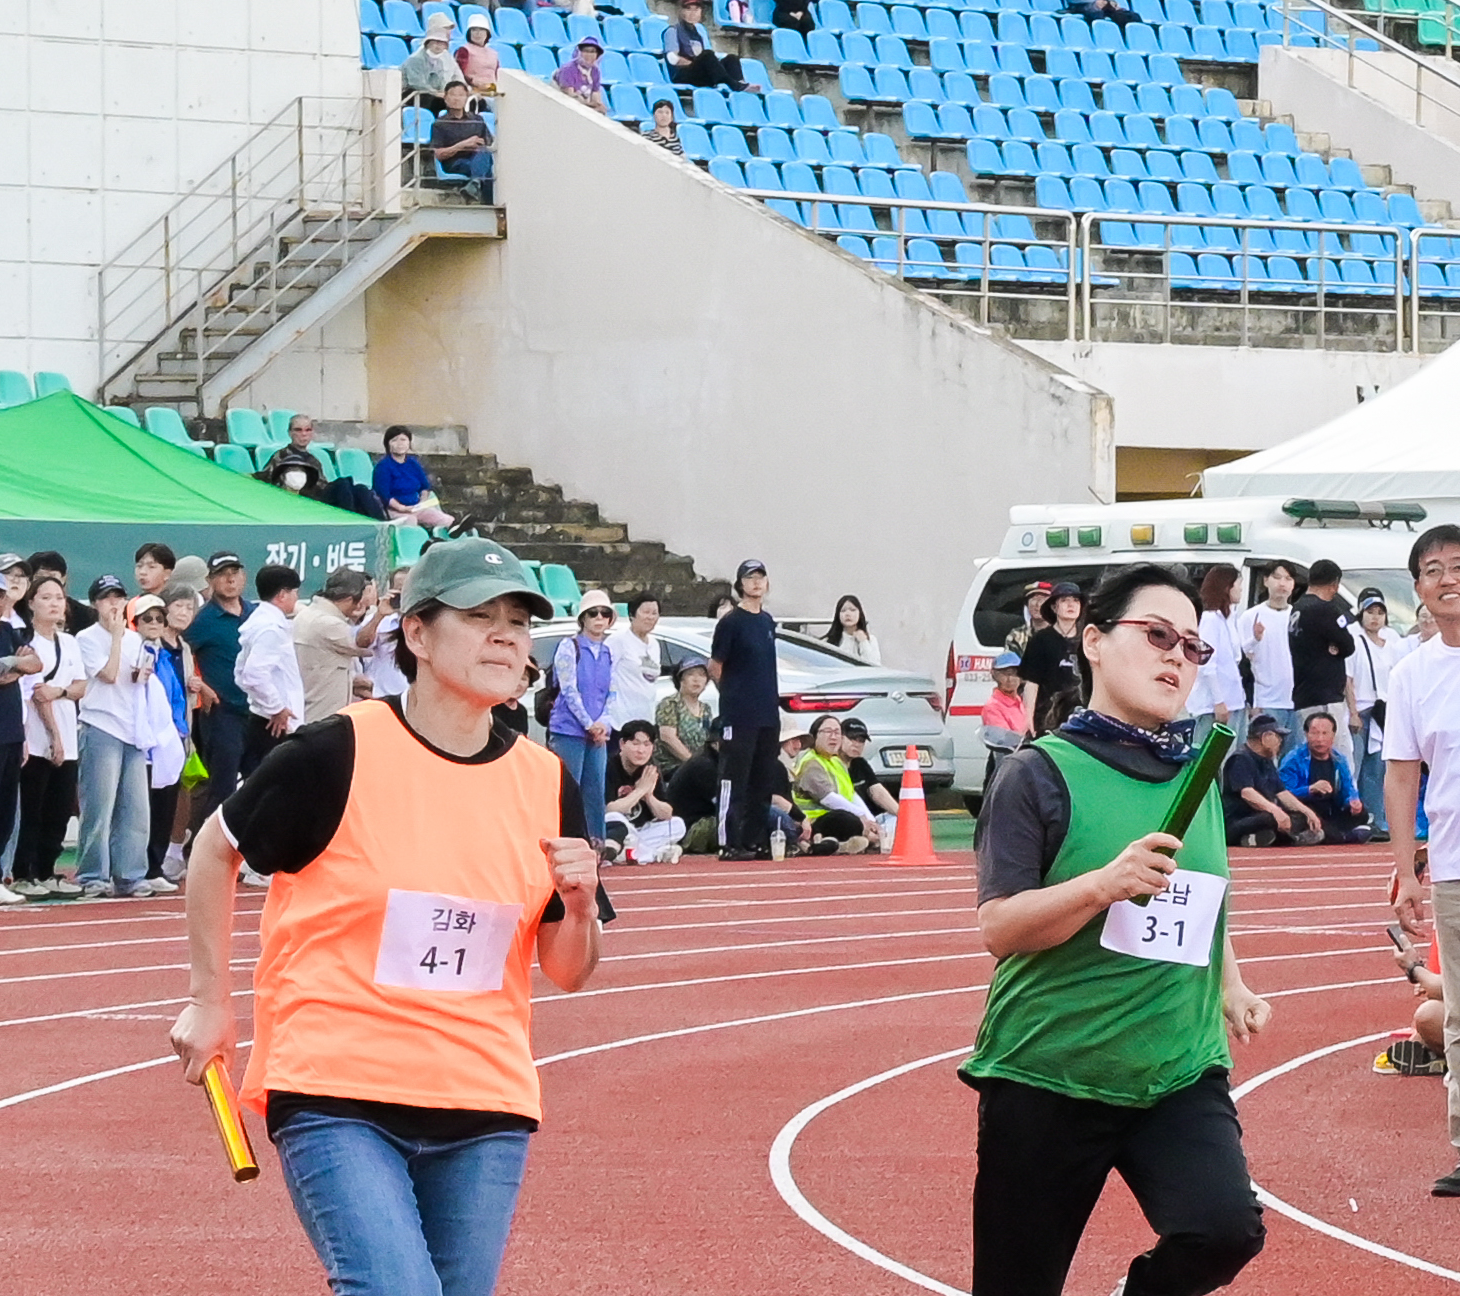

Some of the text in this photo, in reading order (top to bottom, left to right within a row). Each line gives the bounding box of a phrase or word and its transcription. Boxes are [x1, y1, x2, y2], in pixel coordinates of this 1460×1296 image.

[431, 908, 477, 934] 김화
[1141, 915, 1186, 948] 3-1
[419, 946, 467, 976] 4-1
